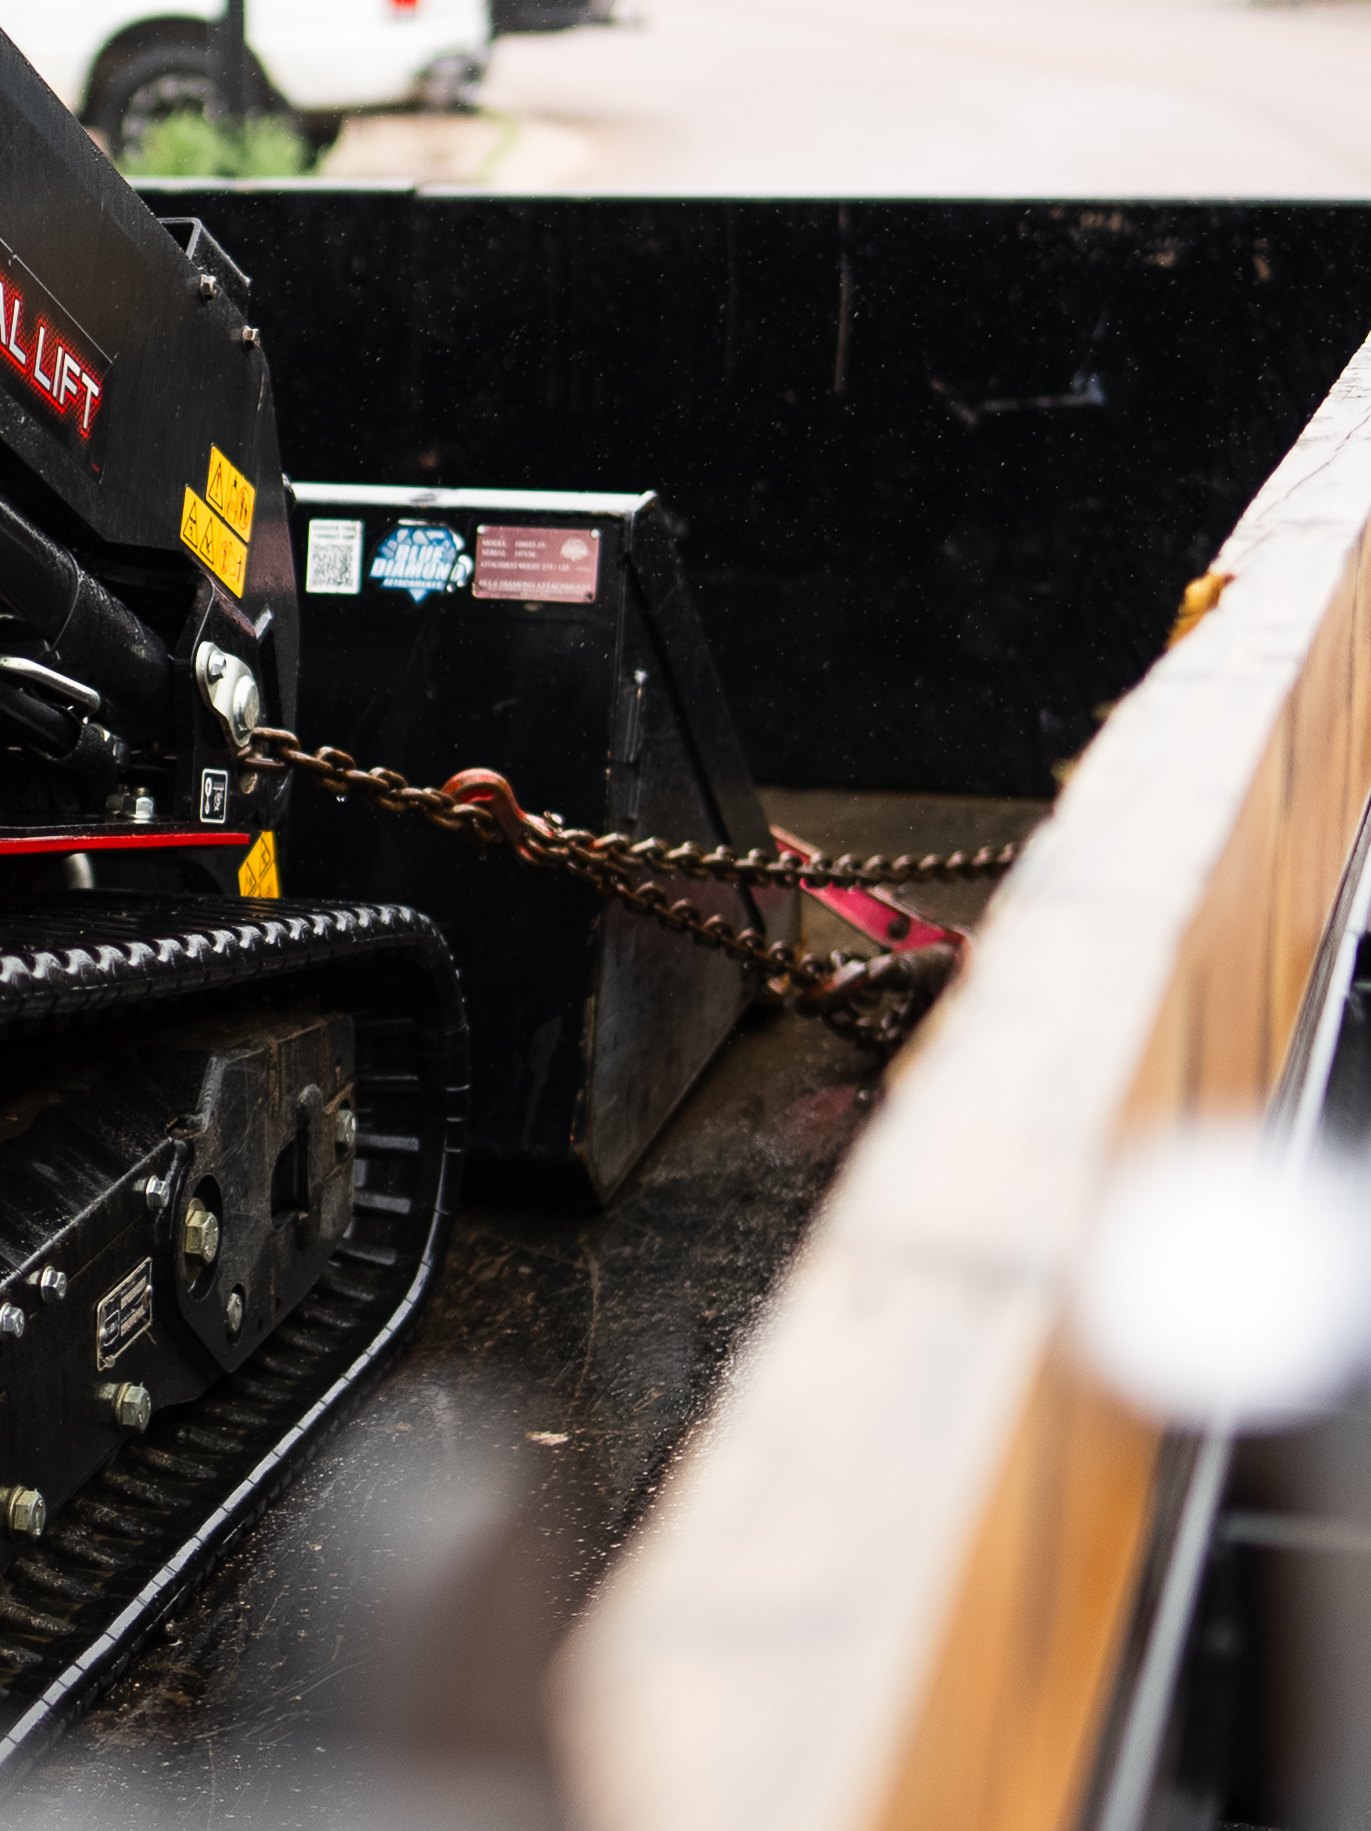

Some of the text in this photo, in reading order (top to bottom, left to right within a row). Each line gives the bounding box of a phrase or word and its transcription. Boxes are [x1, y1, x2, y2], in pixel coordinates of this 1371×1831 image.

[33, 325, 101, 430] LIFT
[394, 544, 443, 563] BLUE
[370, 557, 466, 581] DIAMOND
